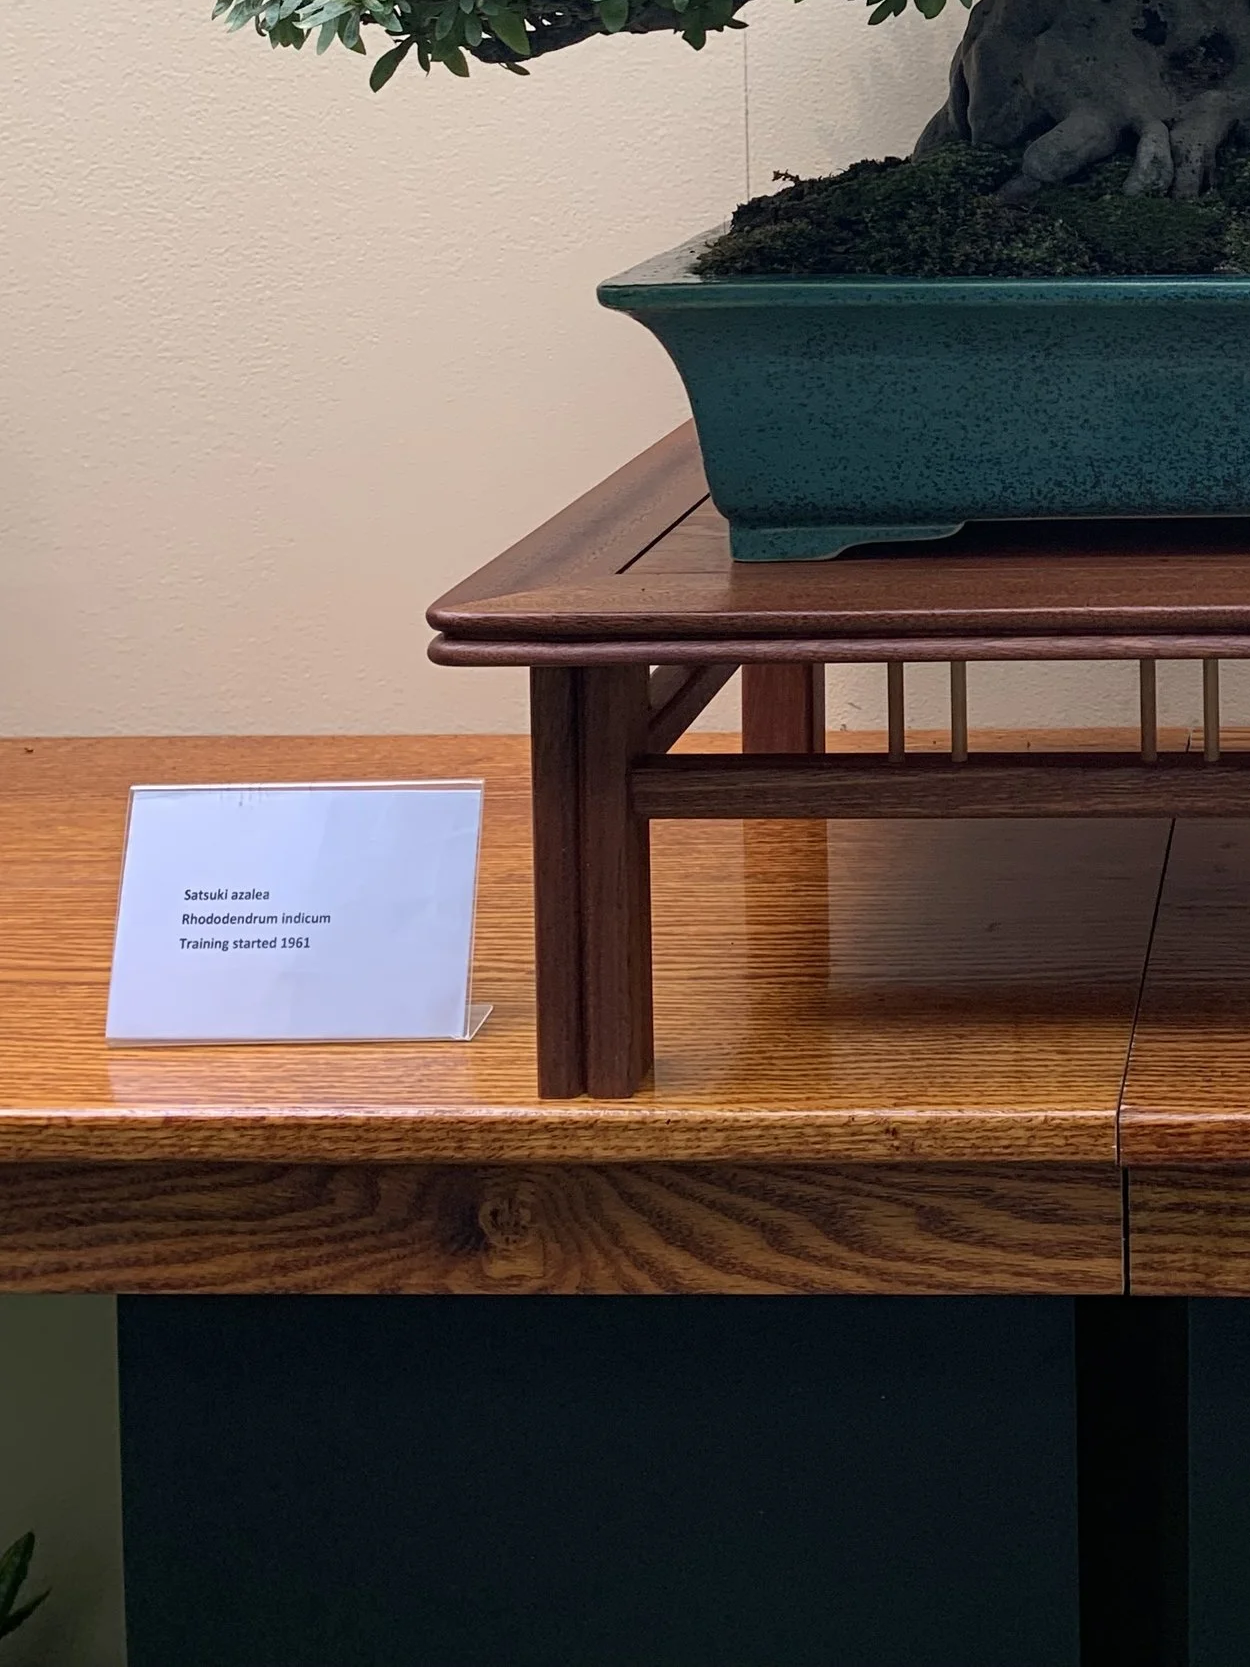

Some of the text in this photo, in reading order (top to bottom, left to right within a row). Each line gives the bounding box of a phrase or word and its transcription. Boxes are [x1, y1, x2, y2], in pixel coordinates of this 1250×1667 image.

[183, 888, 270, 901] Satsuki azalea
[181, 911, 332, 925] Rhododendrum indicum
[179, 936, 311, 952] Training started 1961
